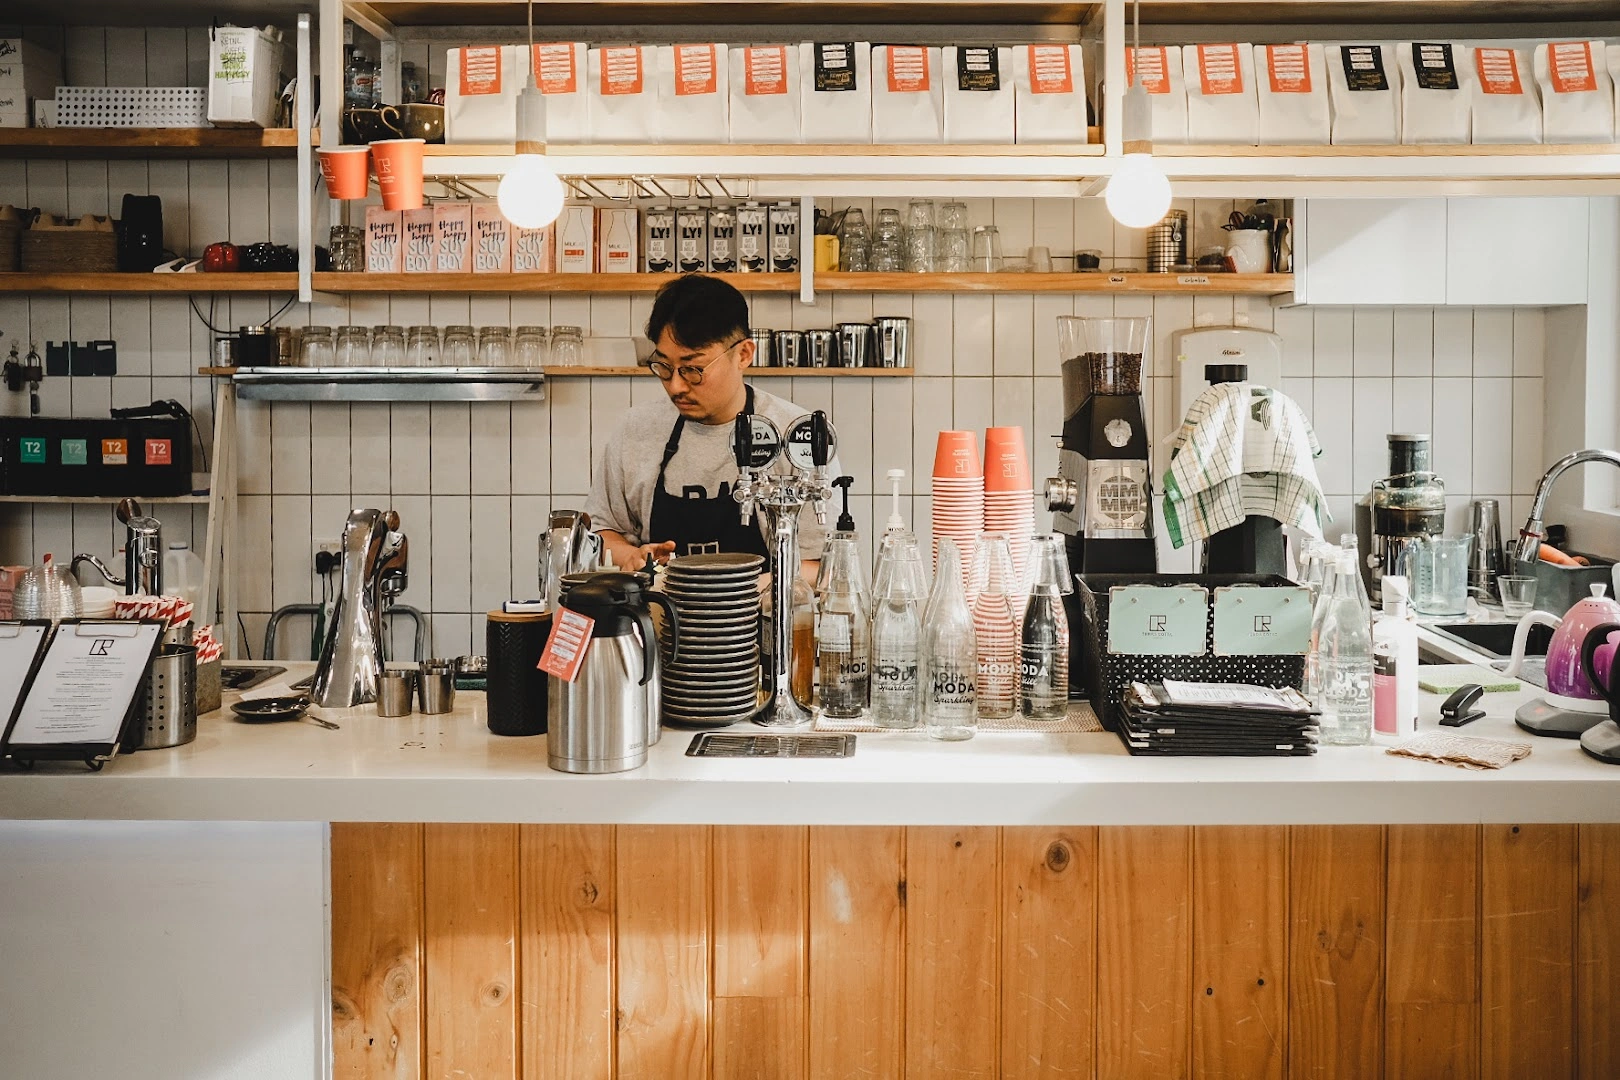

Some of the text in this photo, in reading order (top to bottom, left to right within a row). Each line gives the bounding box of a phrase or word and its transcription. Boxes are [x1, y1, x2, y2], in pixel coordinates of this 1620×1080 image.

[370, 222, 395, 233] Happy
[408, 222, 432, 233] Happy
[439, 220, 464, 231] Happy
[477, 220, 502, 231] Happy
[743, 223, 762, 235] LY!
[775, 223, 795, 235] LY!
[651, 227, 670, 239] LY!
[682, 227, 702, 239] LY!
[714, 226, 734, 238] LY!
[370, 239, 398, 257] SOY
[408, 239, 434, 257] SOY
[439, 238, 467, 256] SOY
[479, 238, 506, 256] SOY
[517, 238, 544, 256] SOY
[367, 255, 395, 271] BOY
[406, 255, 433, 271] BOY
[437, 254, 463, 270] BOY
[476, 254, 502, 270] BOY
[514, 254, 540, 270] BOY
[752, 432, 771, 441] DA
[795, 431, 811, 441] MO
[25, 441, 41, 453] T2
[67, 443, 82, 454] T2
[107, 442, 122, 453] T2
[150, 443, 166, 455] T2
[840, 662, 866, 673] MOD
[978, 663, 1016, 674] MODA
[1021, 663, 1049, 676] ODA
[934, 681, 975, 694] MODA
